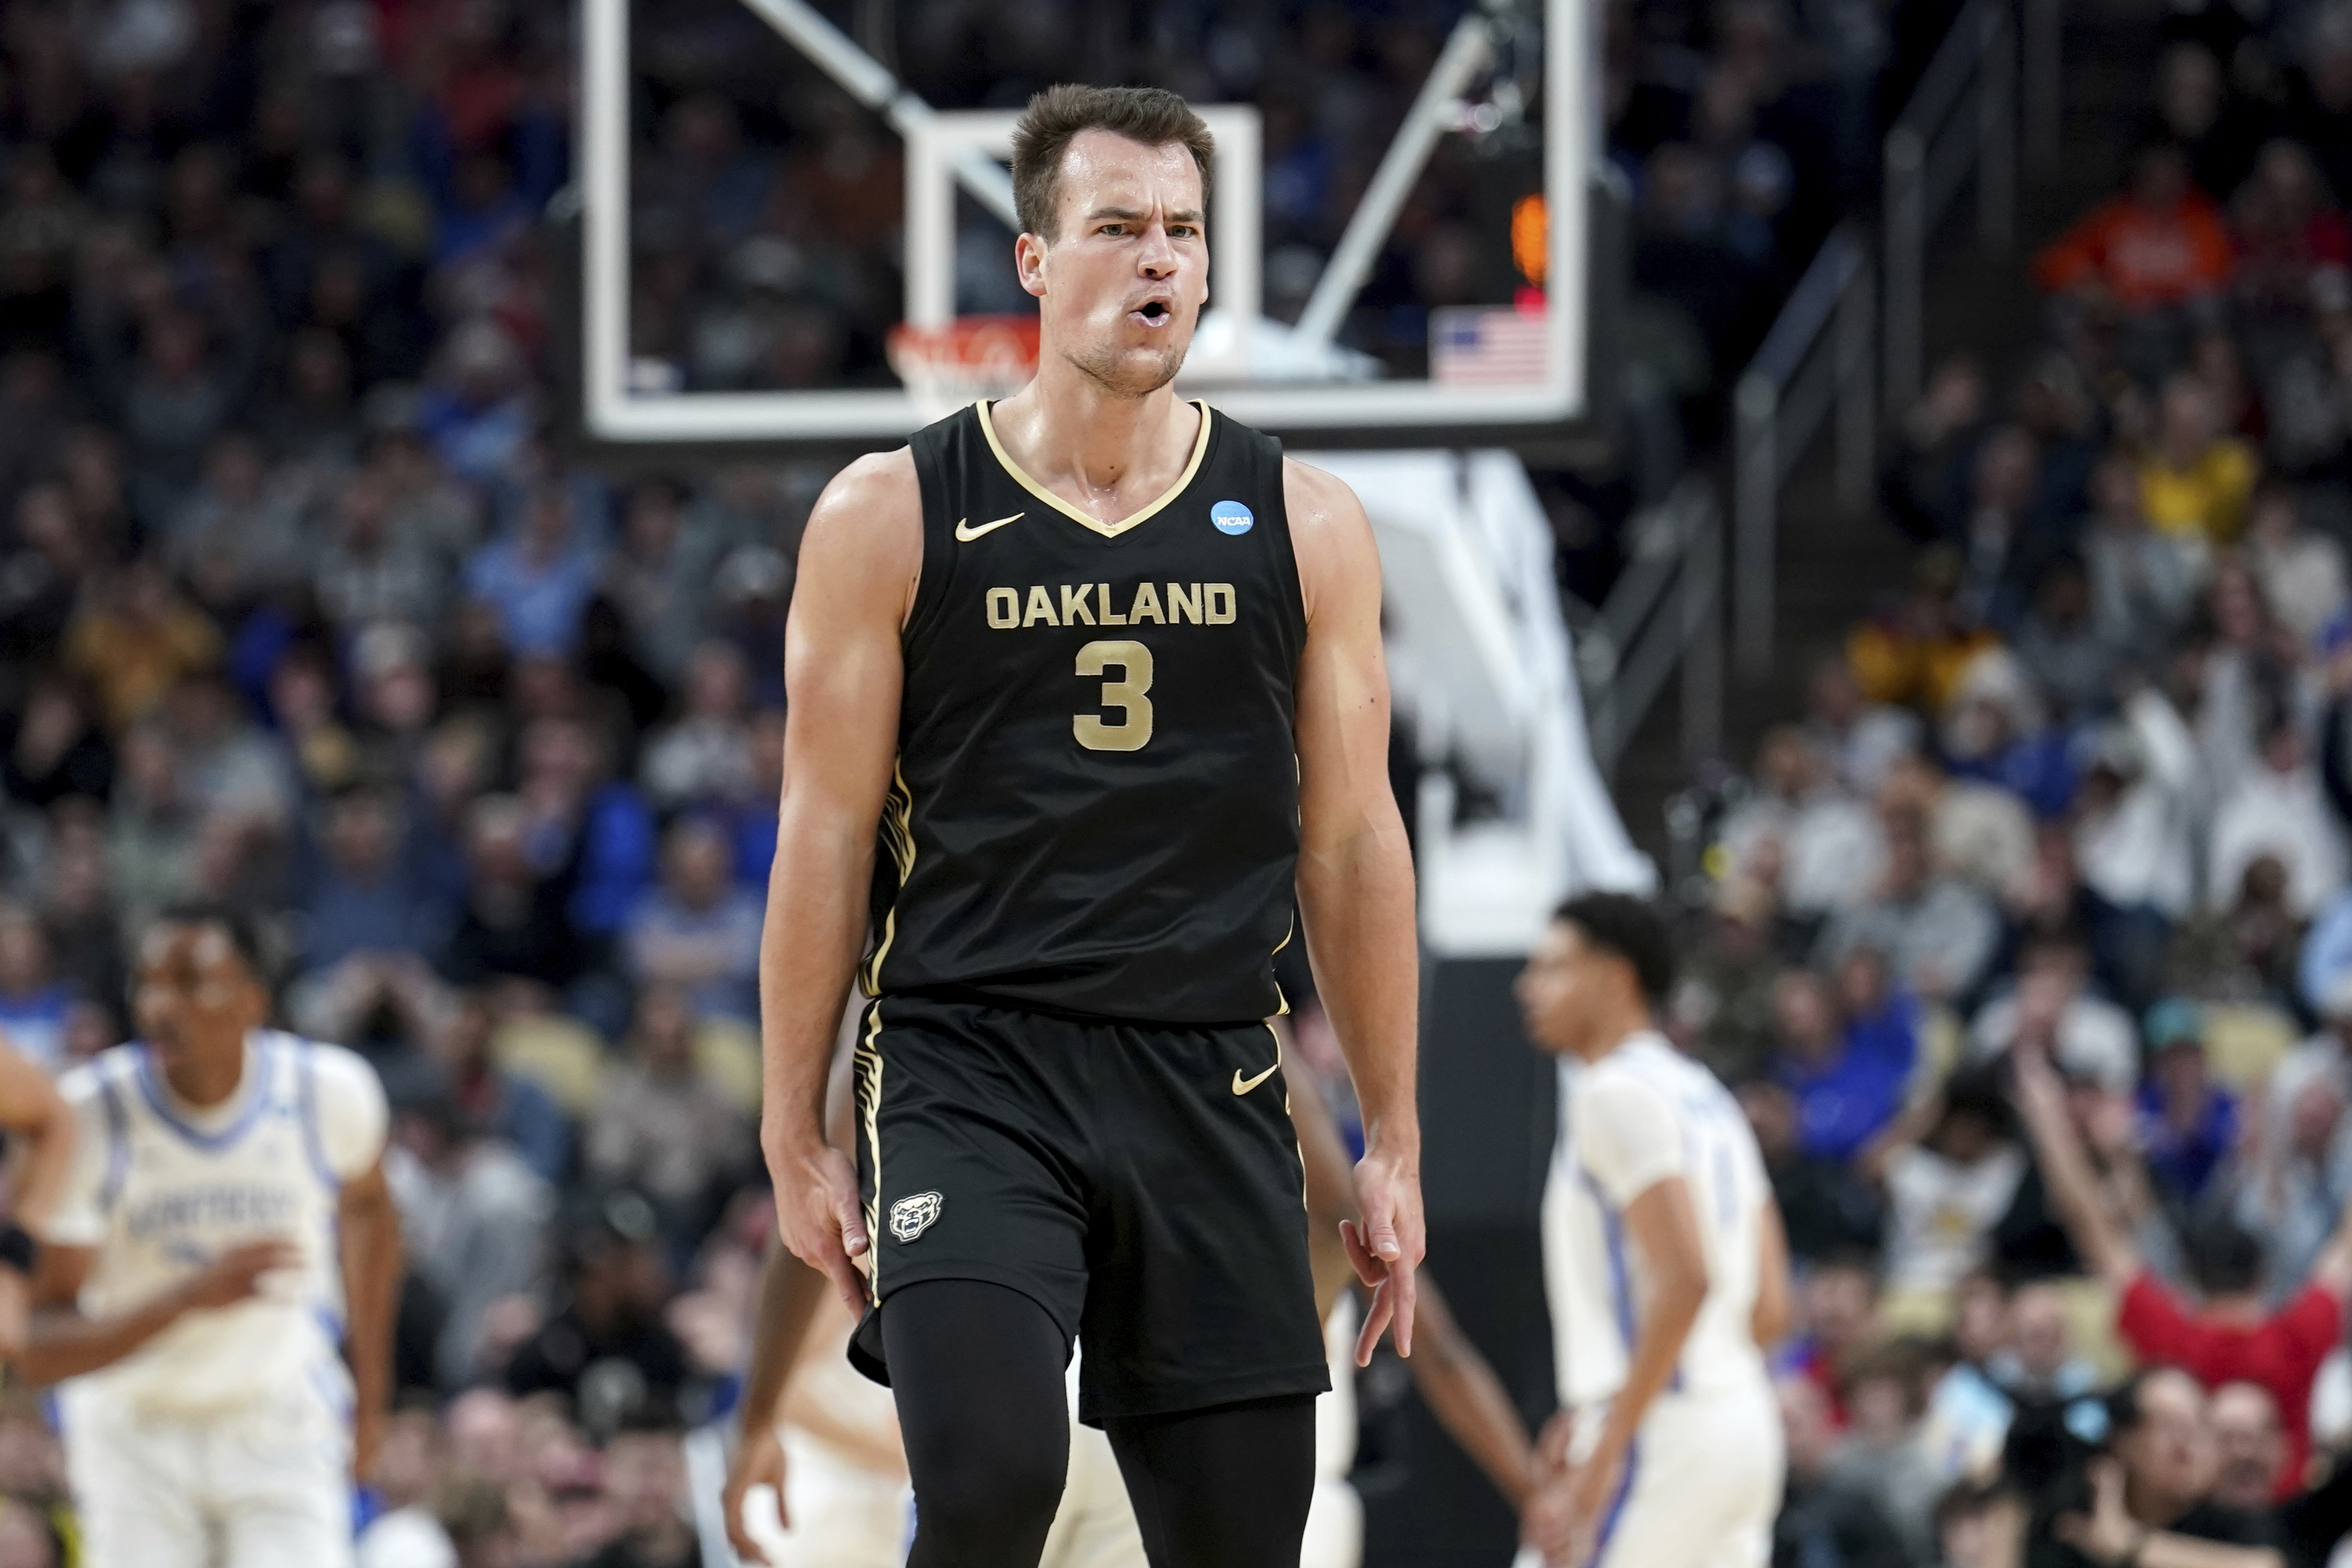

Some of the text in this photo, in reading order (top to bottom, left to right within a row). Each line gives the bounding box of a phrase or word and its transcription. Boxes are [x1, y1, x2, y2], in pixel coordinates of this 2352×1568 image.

[1217, 516, 1251, 526] NCAA
[986, 582, 1237, 629] OAKLAND
[1073, 640, 1154, 751] 3
